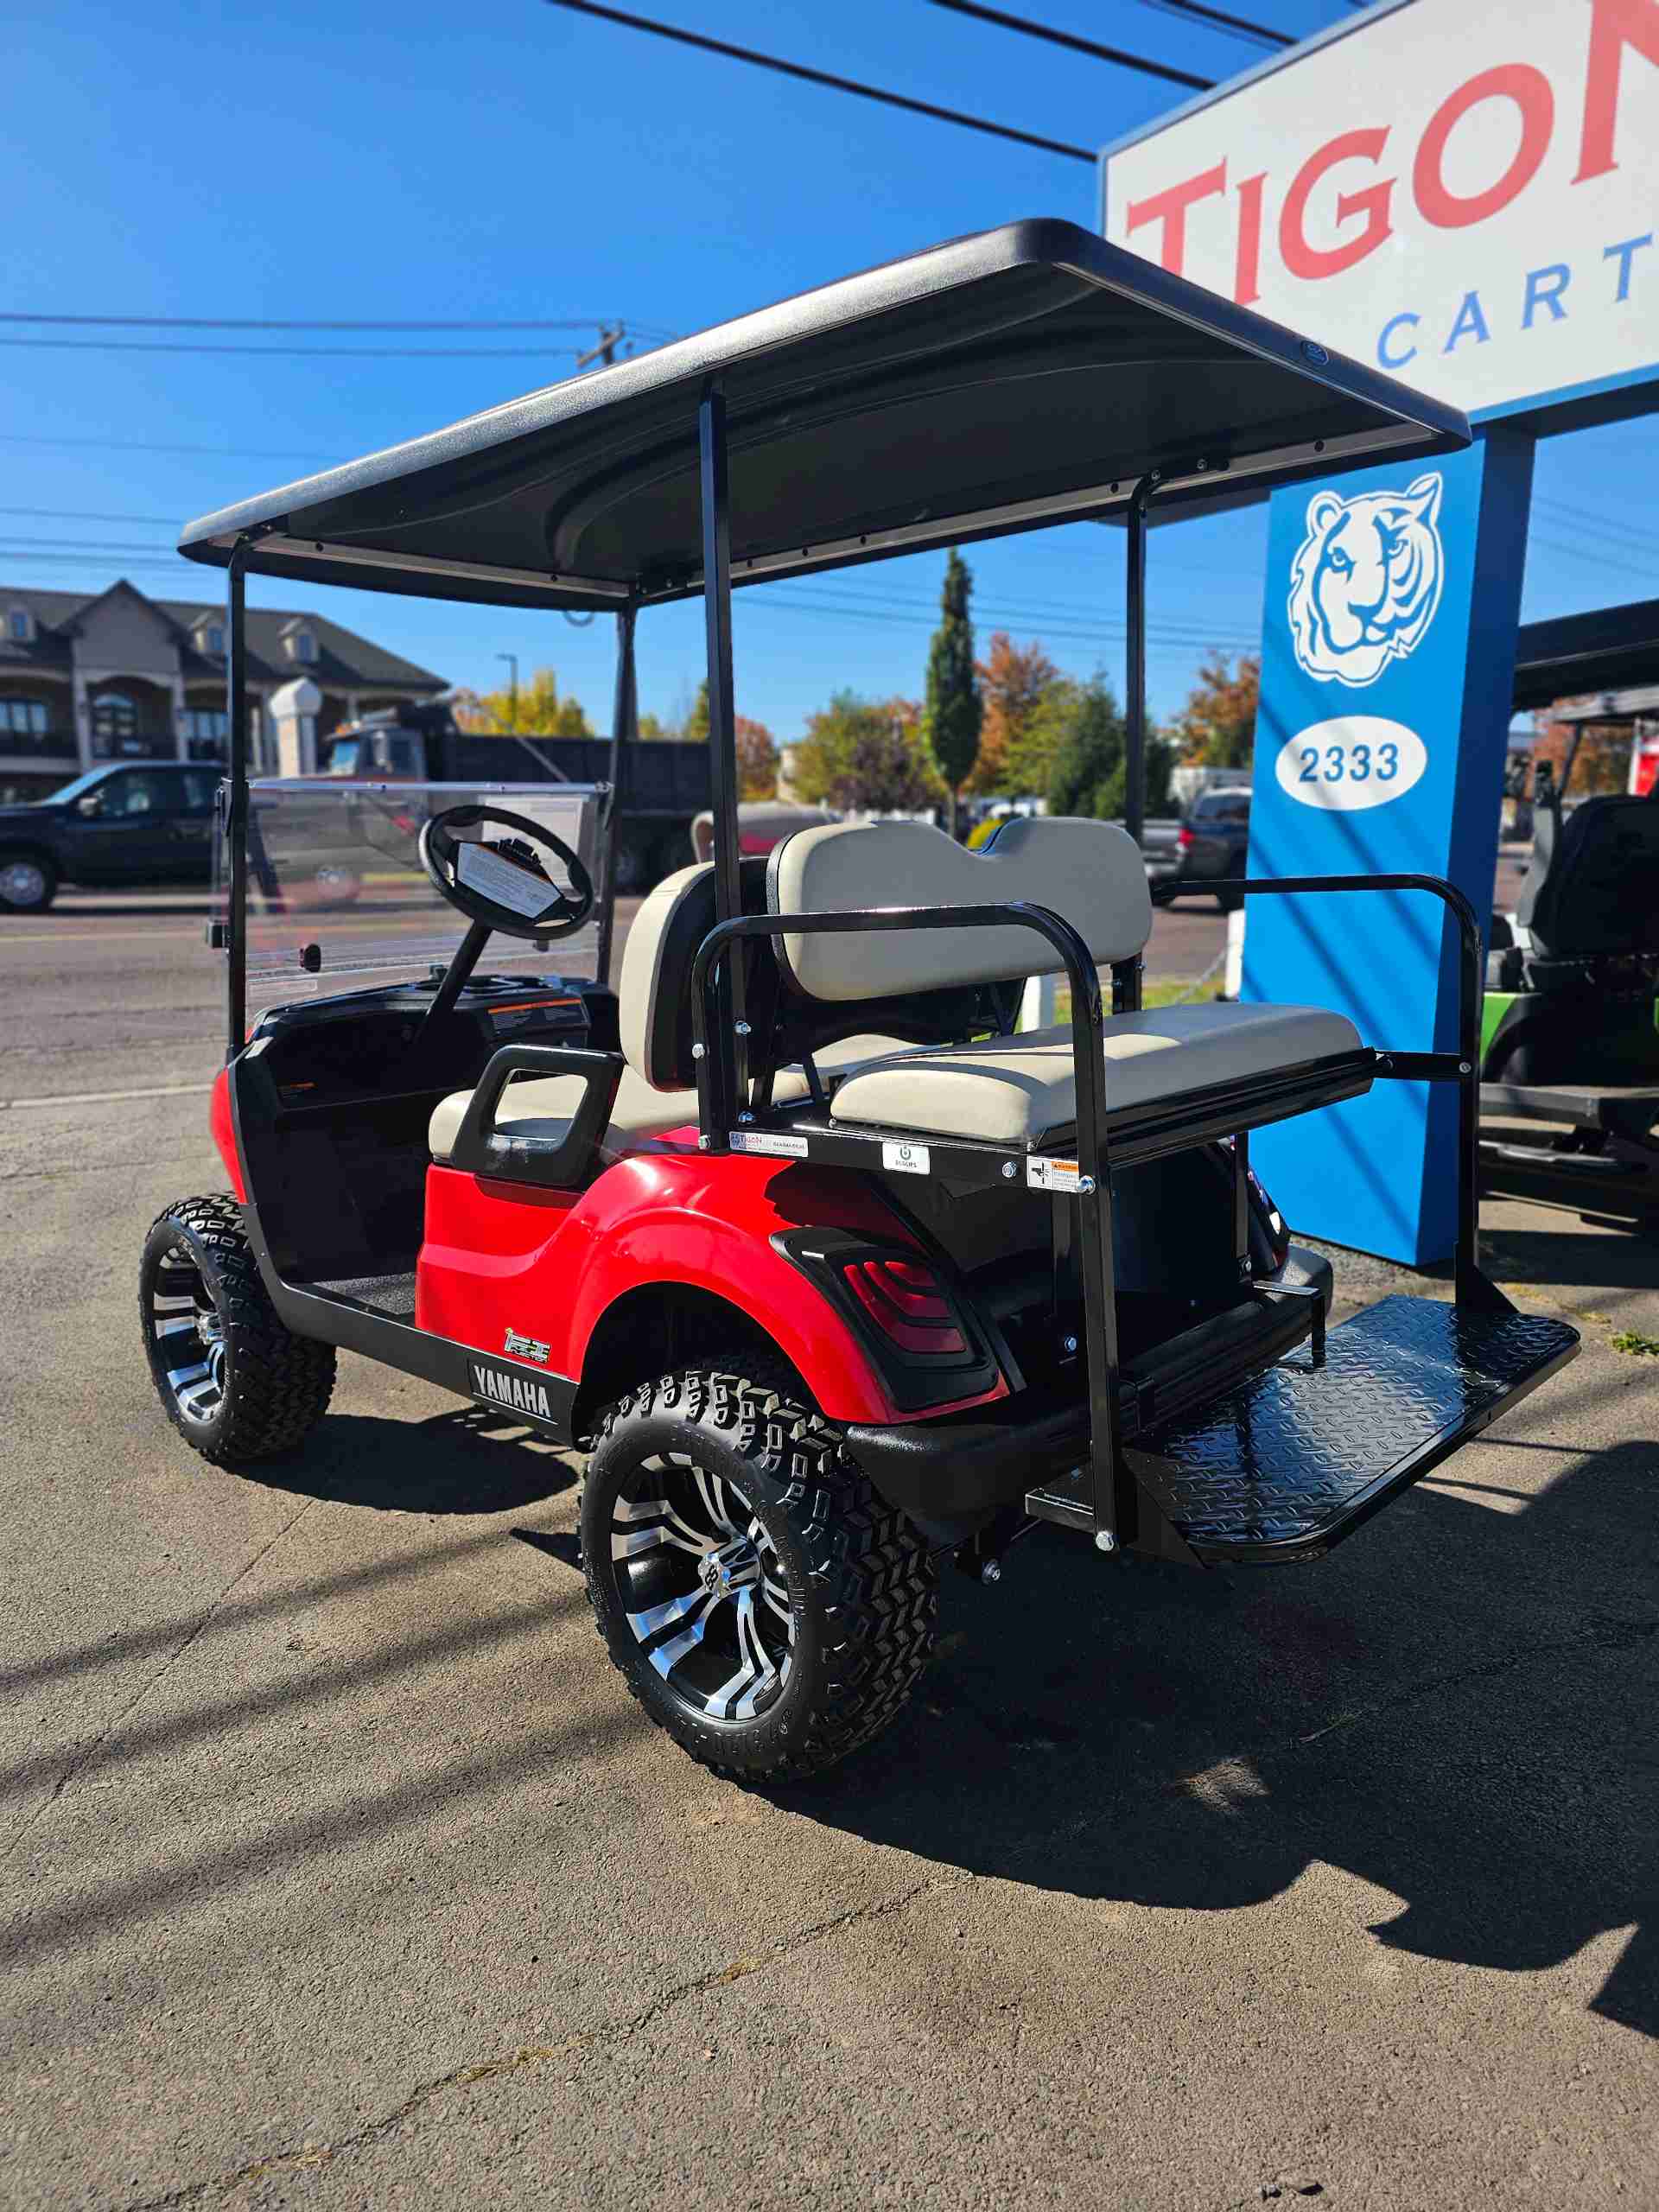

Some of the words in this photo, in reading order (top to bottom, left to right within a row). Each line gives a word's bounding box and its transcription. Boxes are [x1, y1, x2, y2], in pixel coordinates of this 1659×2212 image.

[1376, 232, 1654, 370] CART
[1299, 742, 1399, 783] 2333
[474, 1364, 551, 1418] YAMAHA
